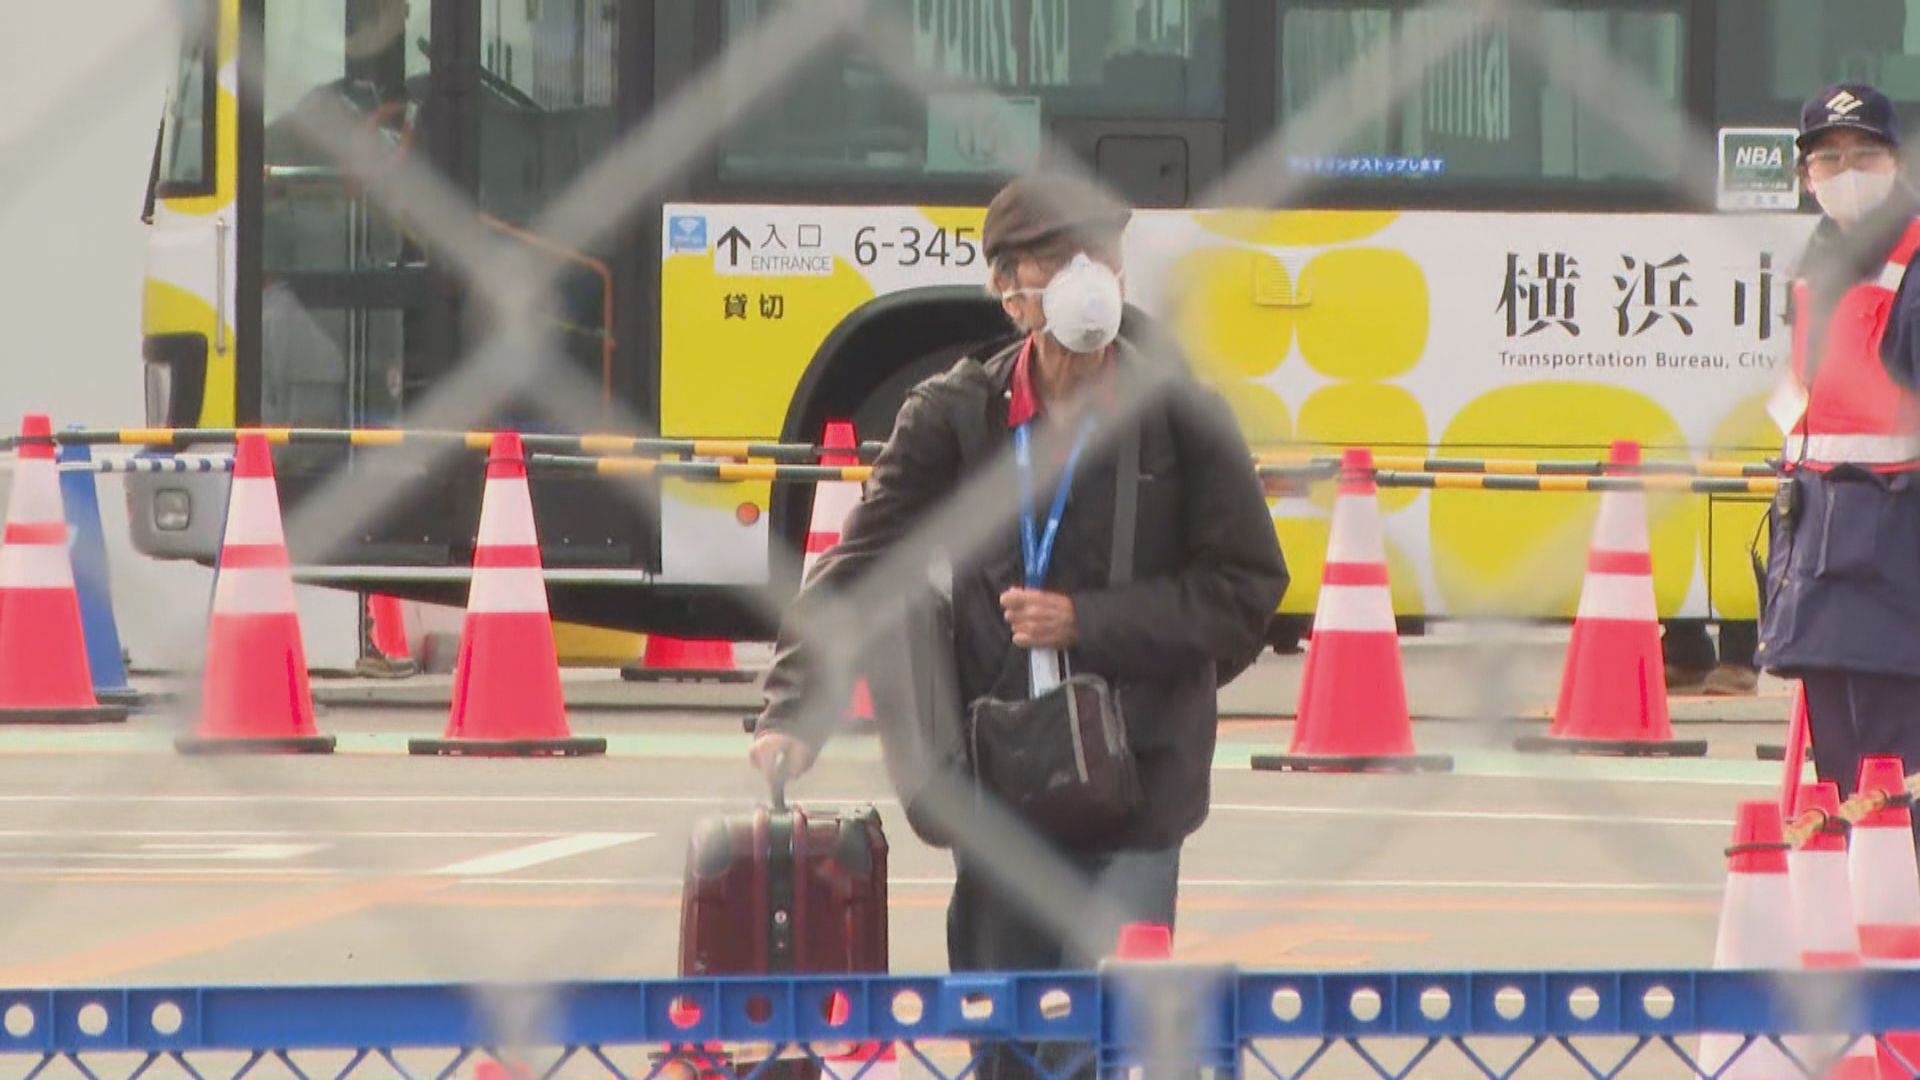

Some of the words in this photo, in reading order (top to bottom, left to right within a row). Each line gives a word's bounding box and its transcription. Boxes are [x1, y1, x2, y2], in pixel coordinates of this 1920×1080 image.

[1735, 147, 1782, 167] NBA
[760, 224, 821, 248] 入口
[854, 226, 976, 266] 6-345
[751, 256, 831, 271] ENTRANCE
[724, 294, 784, 319] 貸切
[1499, 351, 1647, 368] Transportation
[1656, 351, 1729, 368] Bureau,
[1739, 351, 1777, 369] City
